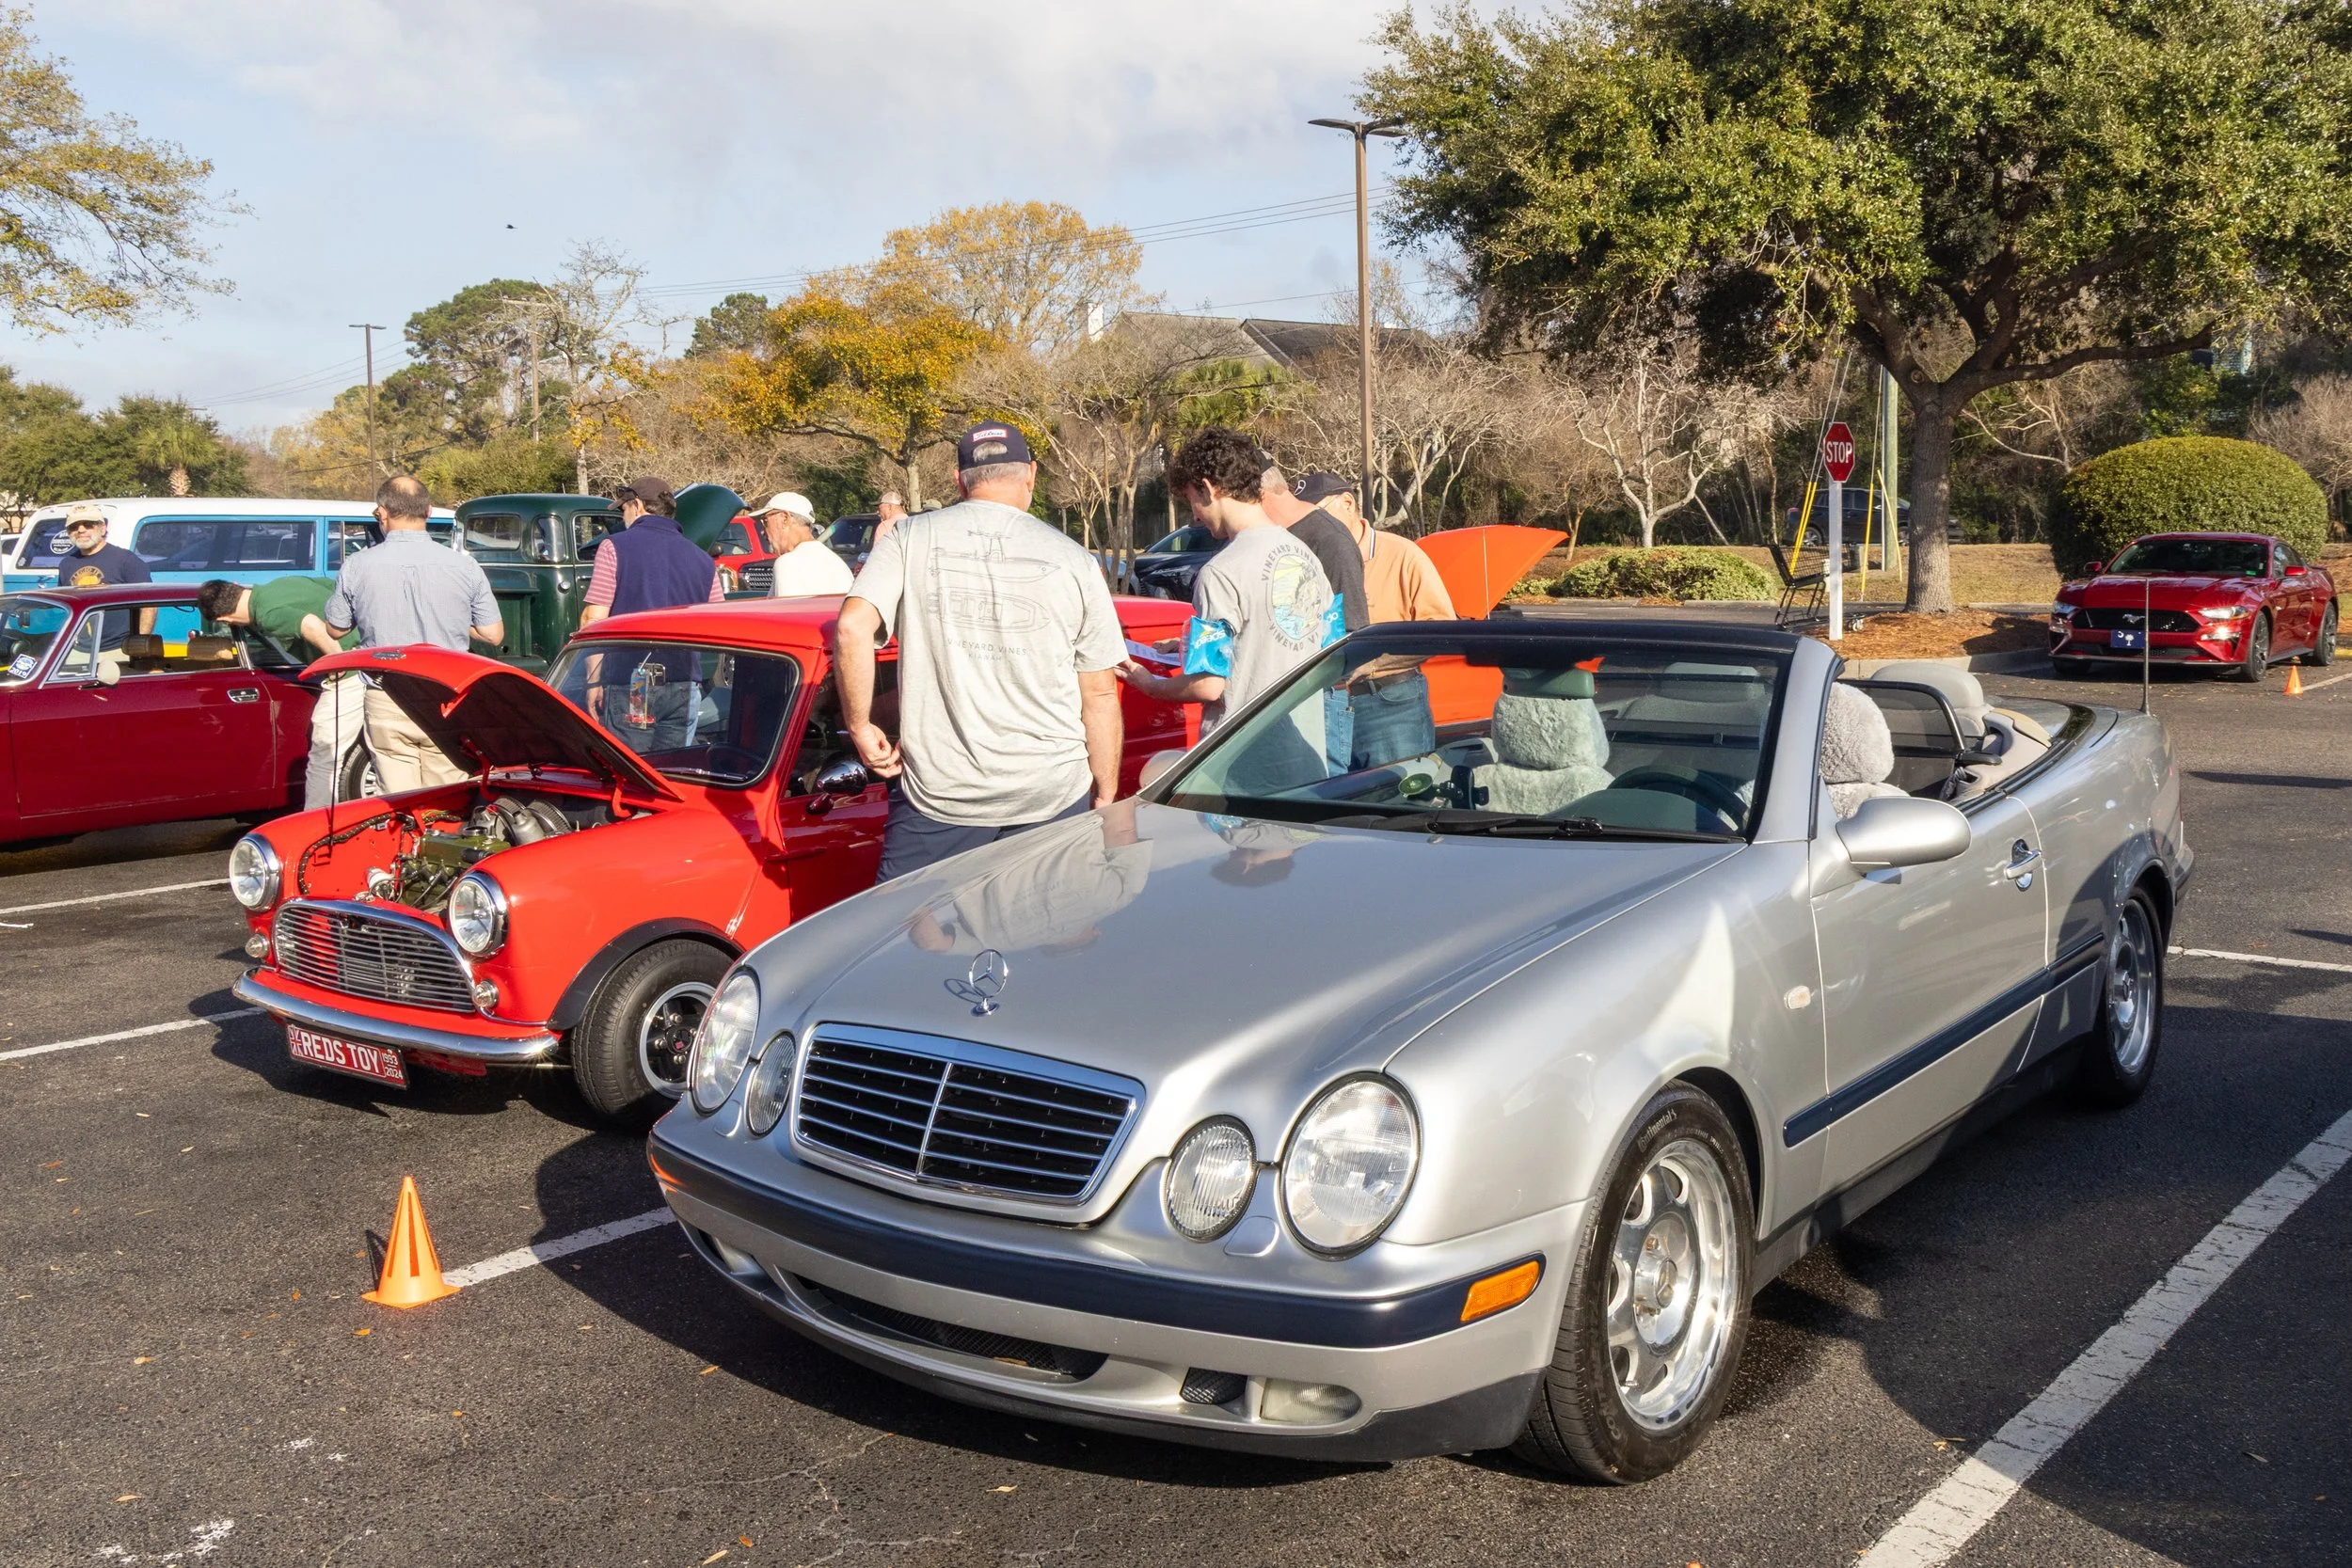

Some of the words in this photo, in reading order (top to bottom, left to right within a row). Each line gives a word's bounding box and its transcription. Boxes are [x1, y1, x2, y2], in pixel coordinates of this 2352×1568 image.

[1826, 441, 1852, 464] STOP
[1261, 544, 1292, 581] VINEYARD
[946, 638, 994, 652] VEYARD
[998, 646, 1027, 656] VINES
[300, 1032, 346, 1065] REDS
[345, 1043, 380, 1074] TOY
[385, 1067, 404, 1080] 2024
[1638, 1109, 1674, 1152] Continental
